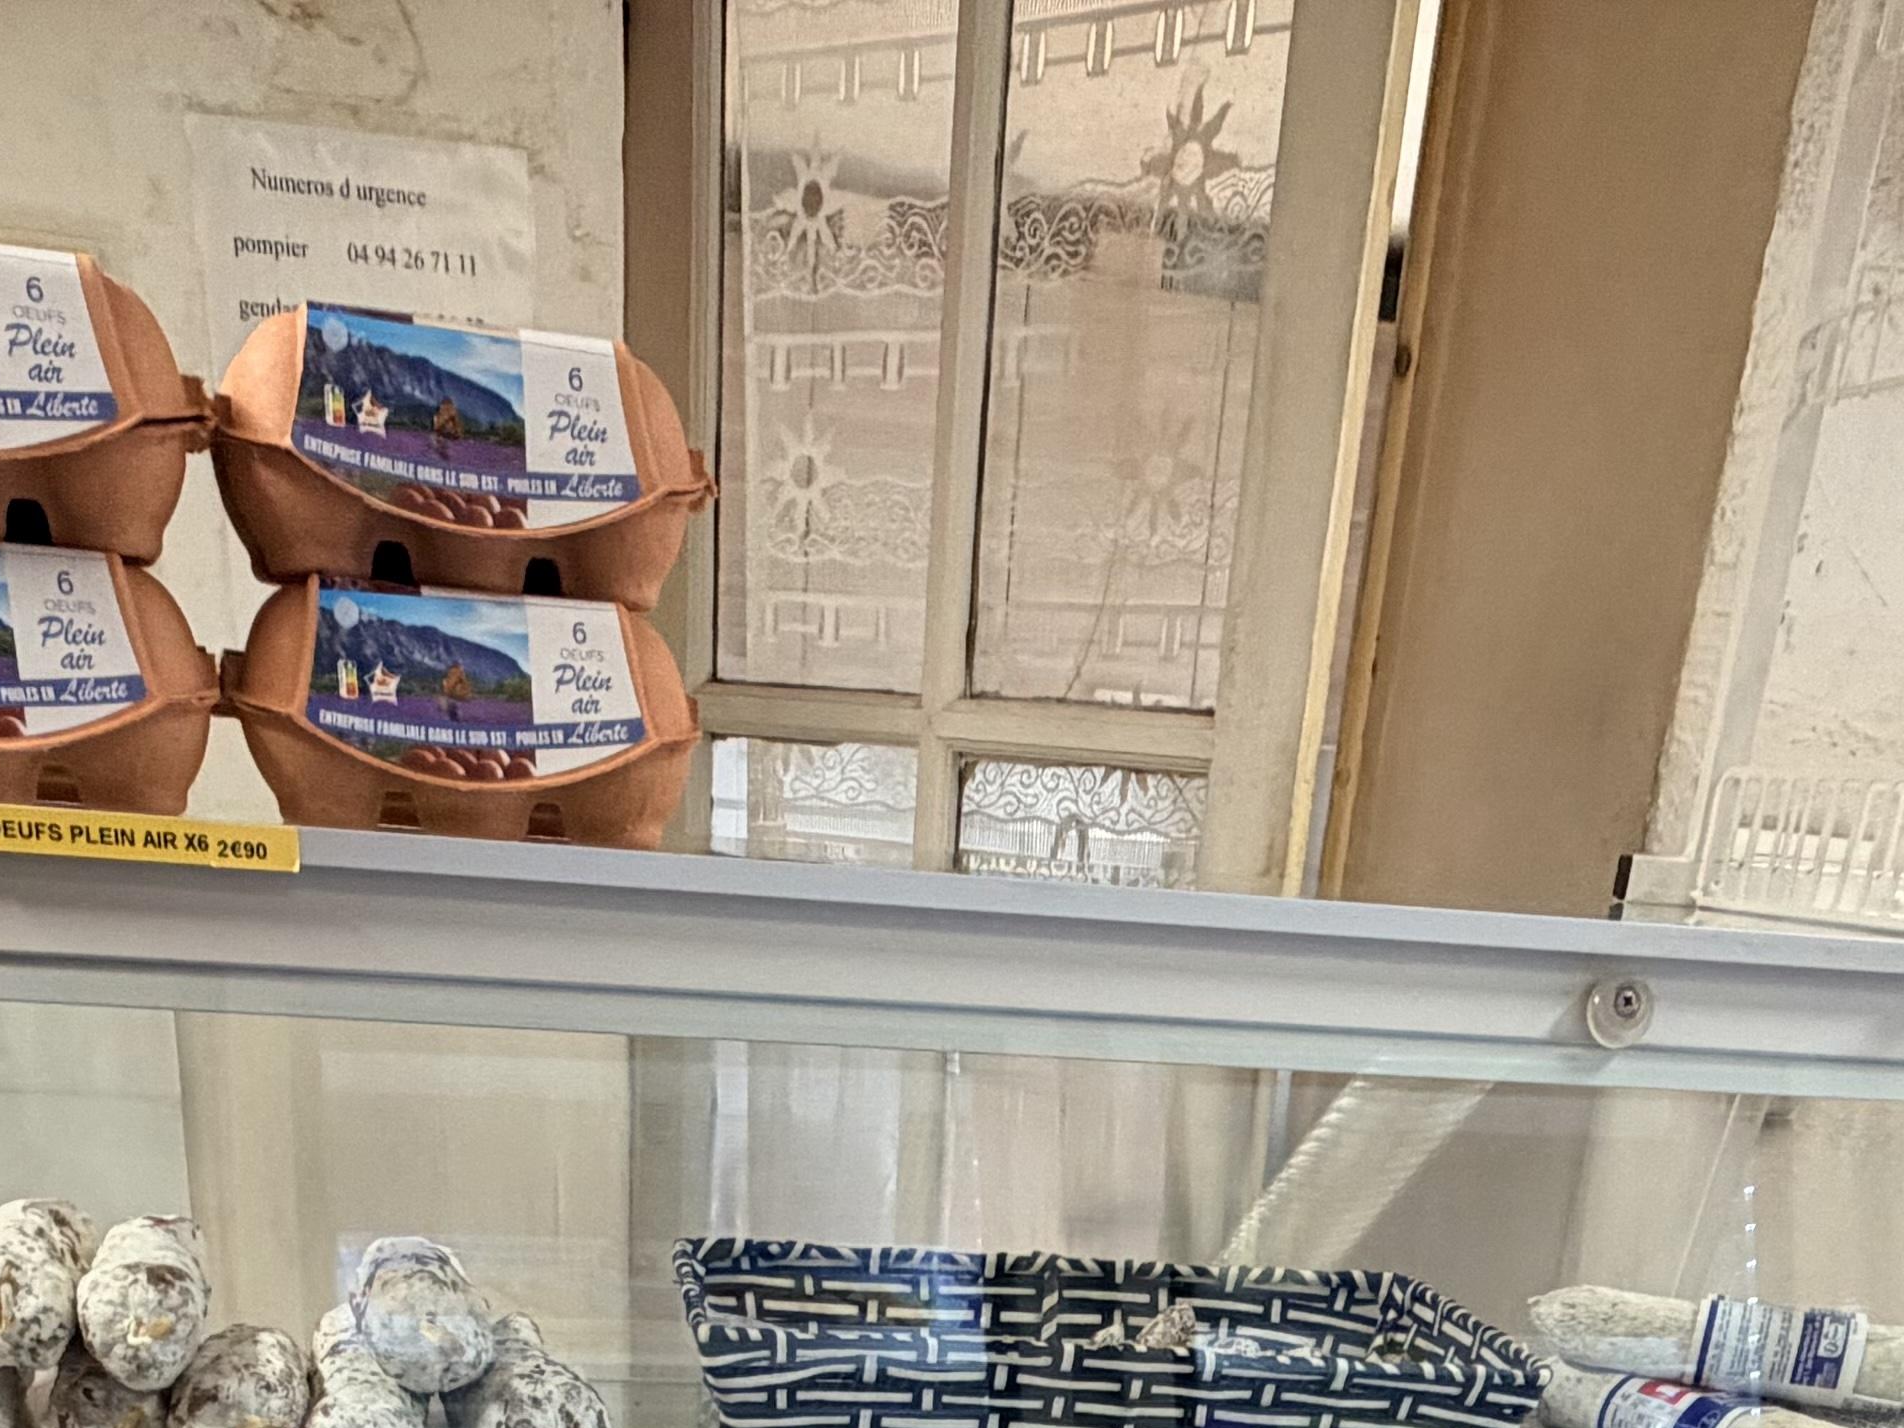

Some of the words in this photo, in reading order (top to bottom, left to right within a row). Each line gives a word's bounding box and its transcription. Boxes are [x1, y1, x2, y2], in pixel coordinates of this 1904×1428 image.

[251, 168, 334, 198] Numeros
[357, 182, 427, 210] urgence
[233, 235, 309, 260] pompier
[347, 241, 369, 263] 04
[375, 243, 396, 266] 94
[403, 247, 424, 271] 26
[432, 250, 451, 274] 71
[458, 253, 477, 277] 11
[26, 276, 44, 303] 6
[5, 322, 77, 360] Plein
[28, 361, 64, 385] air
[569, 367, 583, 391] 6
[547, 410, 608, 444] Plein
[565, 445, 595, 466] air
[57, 570, 74, 595] 6
[37, 615, 105, 647] Plein
[572, 622, 587, 644] 6
[60, 647, 95, 670] air
[553, 663, 613, 693] Plein
[571, 694, 601, 715] air
[71, 825, 135, 848] PLEIN
[142, 829, 177, 852] AIR
[184, 832, 209, 853] X6
[217, 840, 267, 861] 2€90
